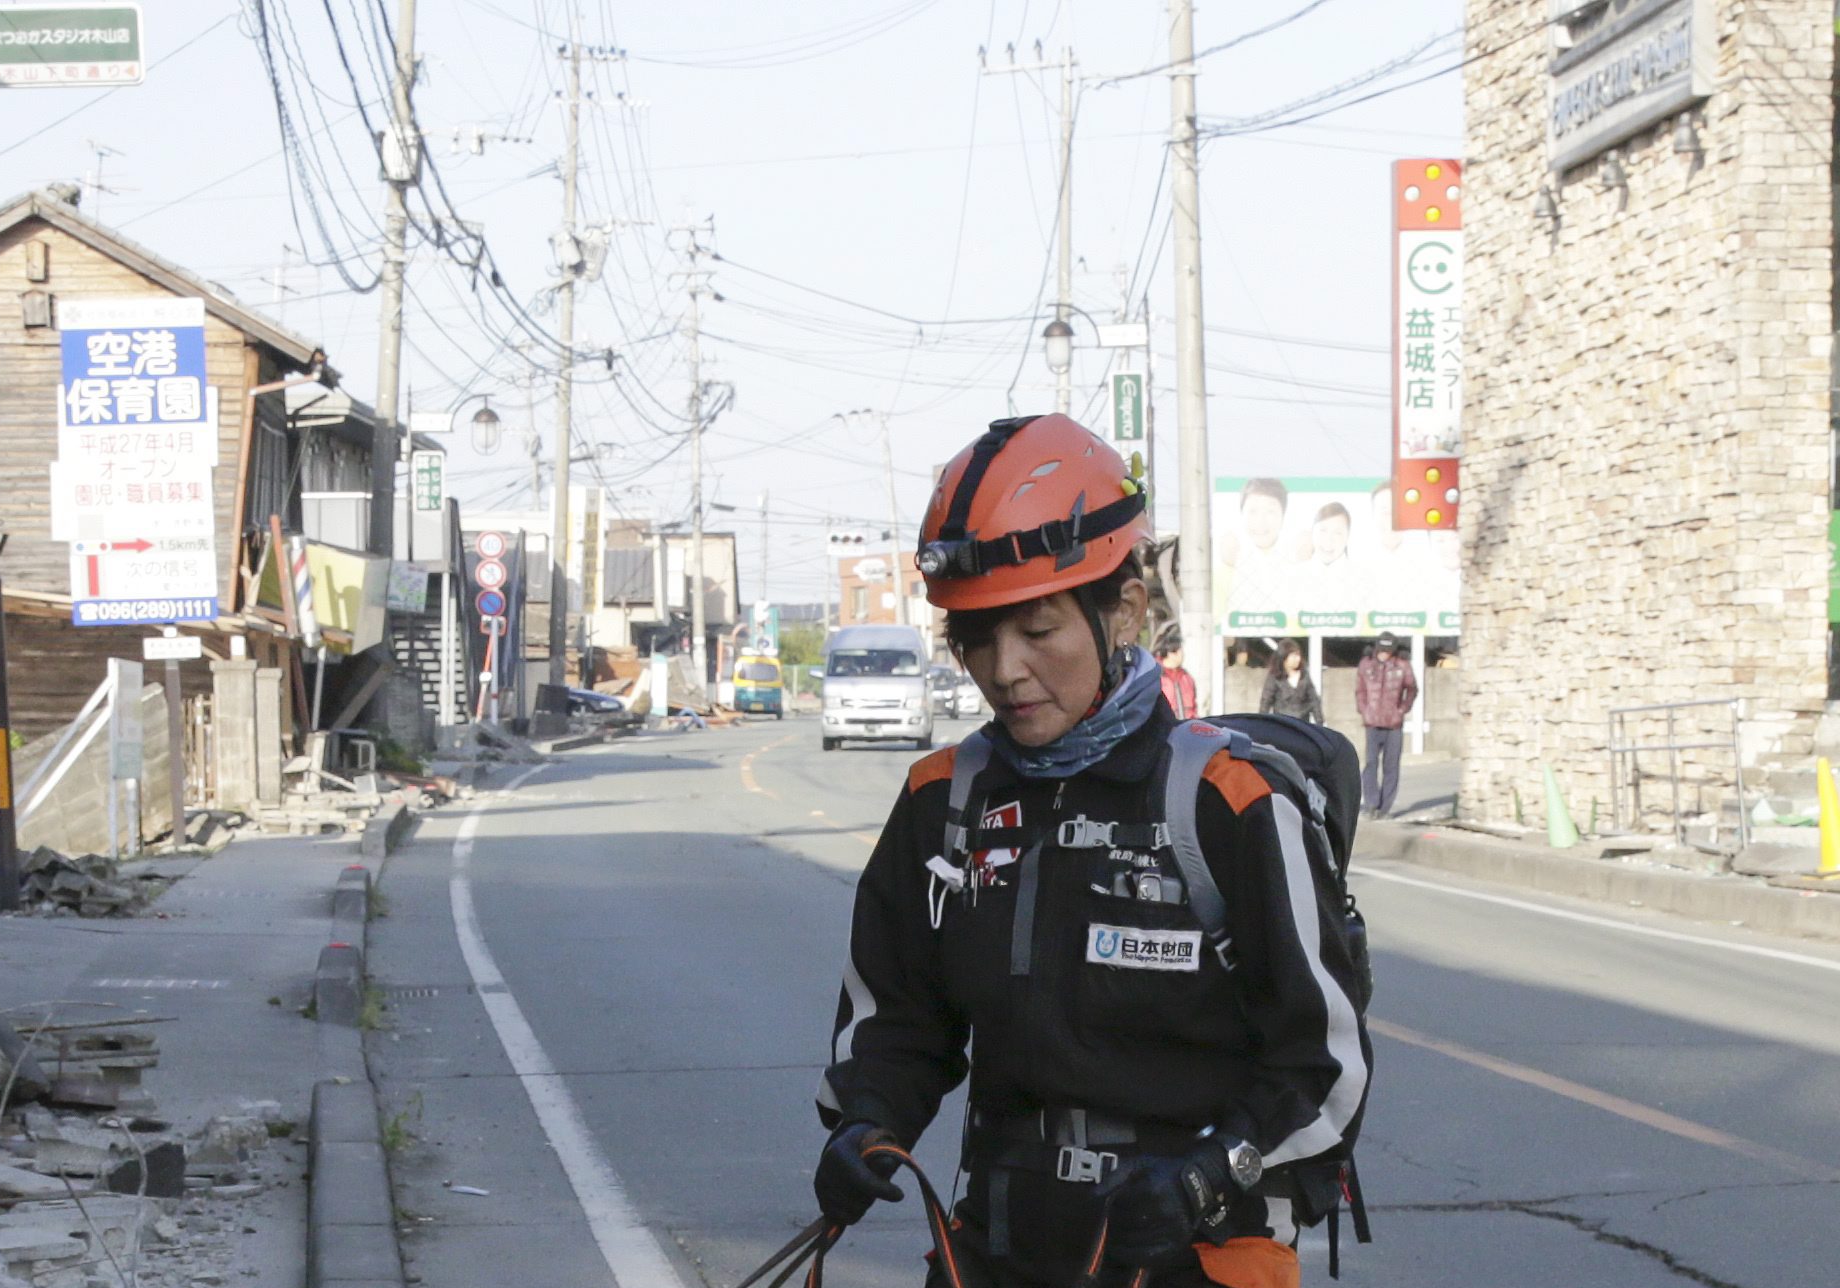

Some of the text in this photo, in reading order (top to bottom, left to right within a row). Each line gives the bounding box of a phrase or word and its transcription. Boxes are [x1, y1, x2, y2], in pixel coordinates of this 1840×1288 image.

[86, 330, 177, 376] 空港
[1405, 308, 1436, 410] 益城店
[66, 376, 201, 424] 保育園
[79, 432, 194, 455] 平成27年4月
[99, 459, 177, 480] オープン
[1121, 938, 1194, 957] 日本財団
